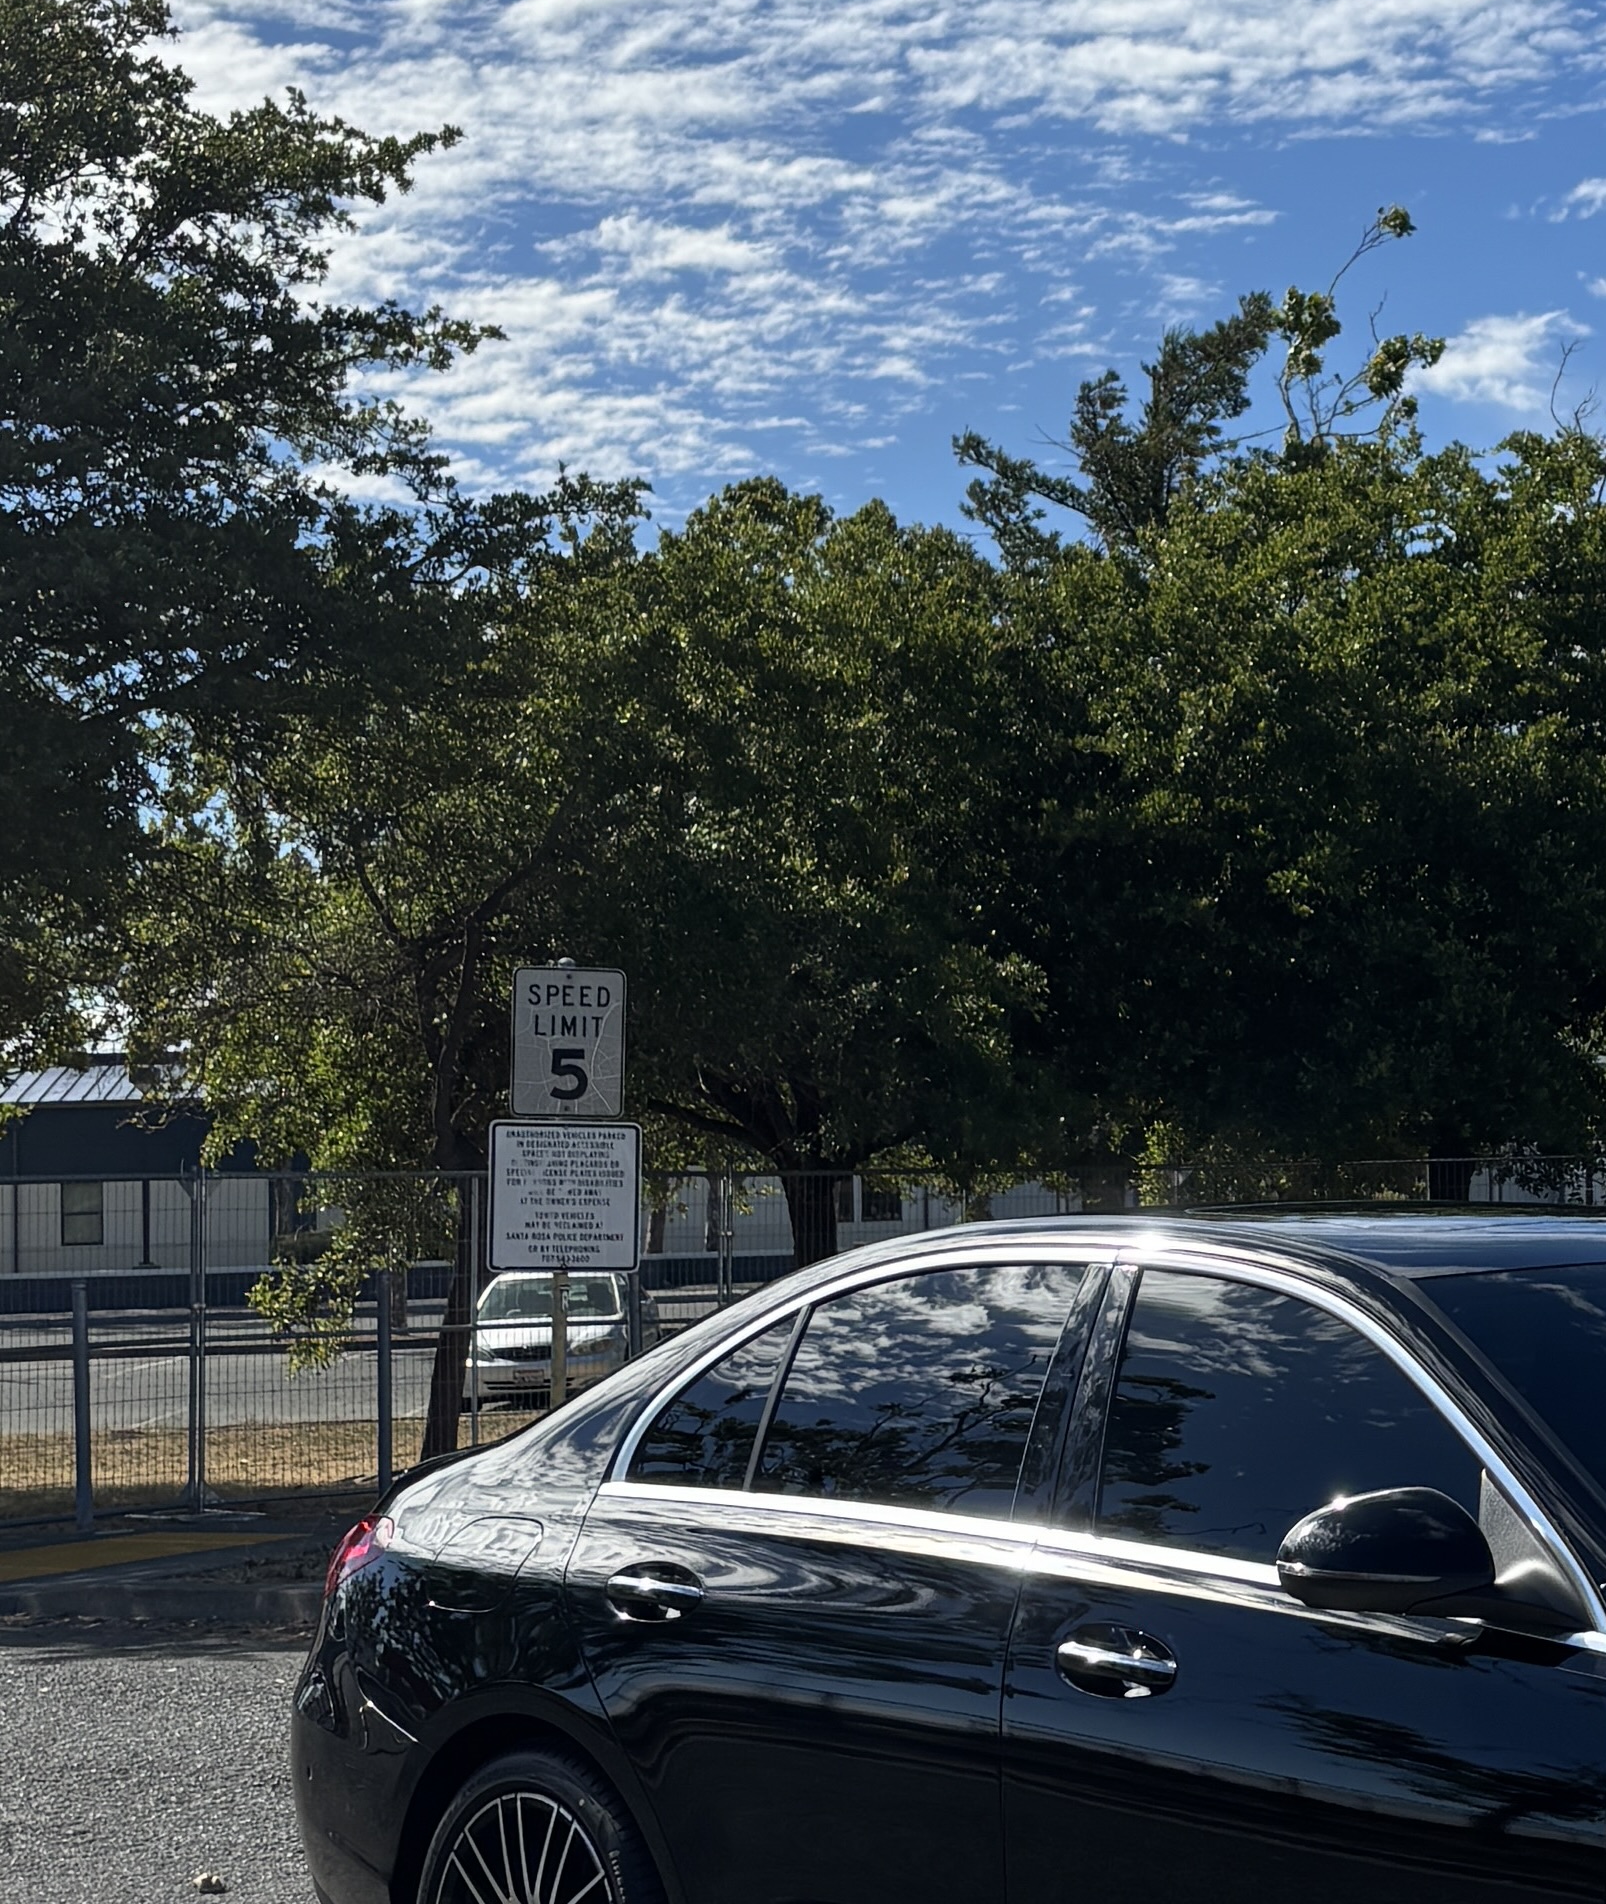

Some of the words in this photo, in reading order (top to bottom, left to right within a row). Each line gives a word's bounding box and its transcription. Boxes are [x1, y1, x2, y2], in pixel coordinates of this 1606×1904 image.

[528, 983, 611, 1008] SPEED
[534, 1014, 604, 1038] LIMIT
[549, 1048, 588, 1100] 5
[563, 1130, 596, 1140] VEHICLES
[598, 1131, 626, 1140] PARKED
[516, 1140, 524, 1148] IN
[570, 1159, 608, 1169] PLACARDS
[540, 1169, 567, 1177] ICENSE
[570, 1169, 596, 1177] PLATES
[578, 1198, 610, 1207] EXPENSE
[561, 1211, 595, 1220] VEHICLES
[525, 1221, 540, 1229] MAY
[542, 1221, 551, 1229] BE
[506, 1232, 528, 1241] SANTA
[531, 1232, 550, 1241] ROSA
[553, 1233, 577, 1241] POLICE
[579, 1233, 624, 1242] DEPARTMENT
